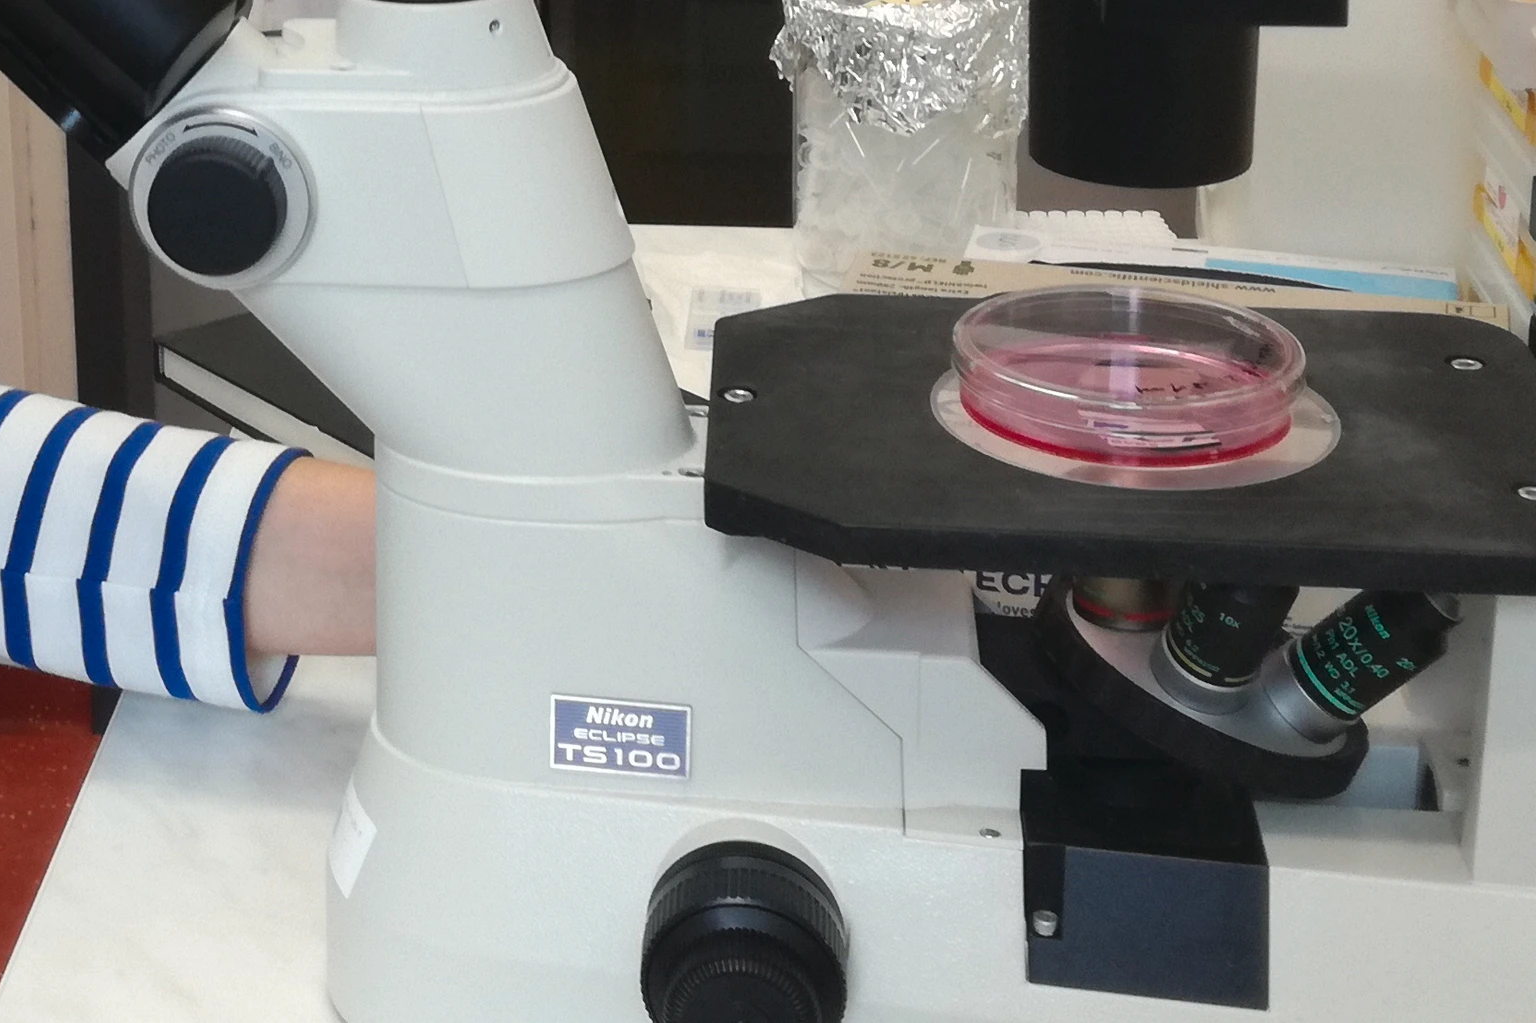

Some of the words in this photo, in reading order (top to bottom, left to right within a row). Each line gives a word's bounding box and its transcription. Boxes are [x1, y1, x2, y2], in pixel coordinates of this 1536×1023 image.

[145, 131, 176, 165] PHOTO
[268, 142, 293, 170] BINO
[872, 259, 934, 273] M/8
[1365, 605, 1390, 639] Nikon
[1336, 653, 1359, 678] ADL
[586, 706, 654, 729] Nikon
[573, 727, 665, 747] ECLIPSE
[557, 742, 681, 771] TS100
